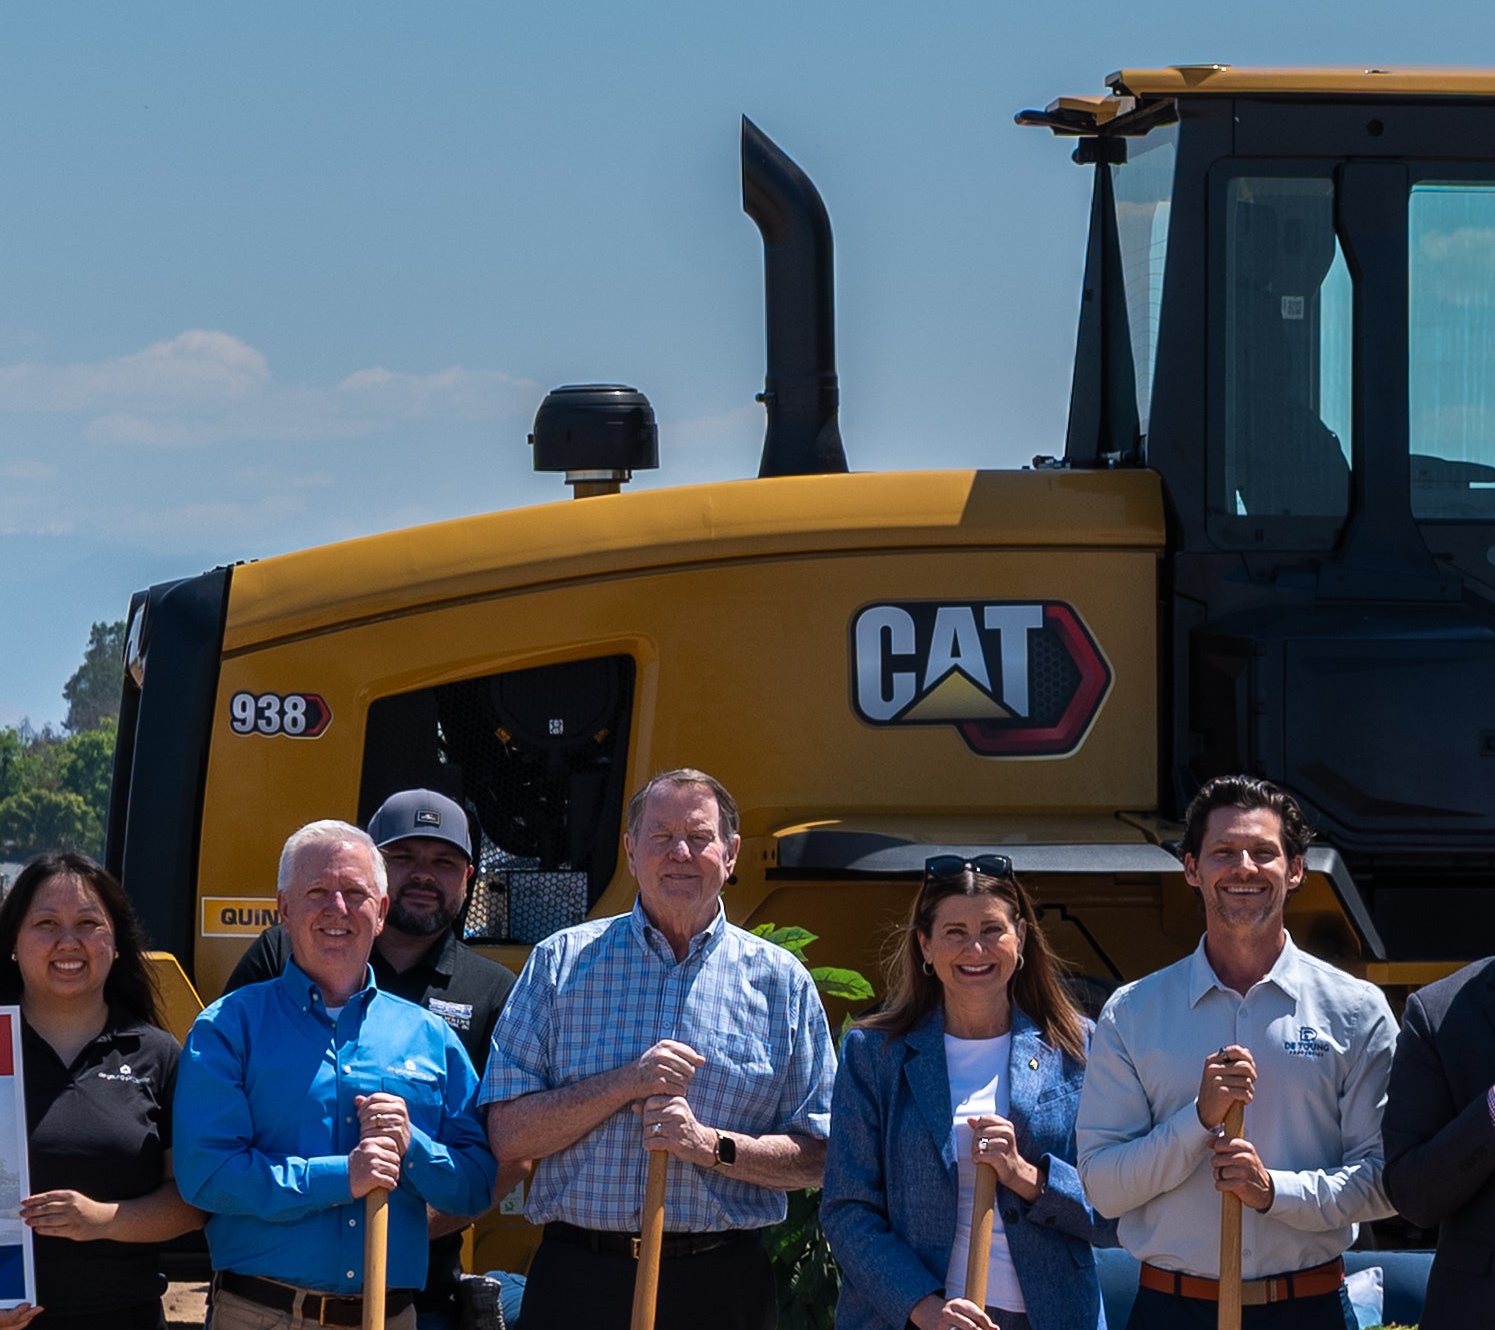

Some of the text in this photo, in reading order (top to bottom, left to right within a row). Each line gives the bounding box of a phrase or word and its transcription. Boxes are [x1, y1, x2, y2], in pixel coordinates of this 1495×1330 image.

[855, 604, 1044, 721] CAT
[232, 693, 307, 734] 938
[220, 908, 279, 926] QUIN
